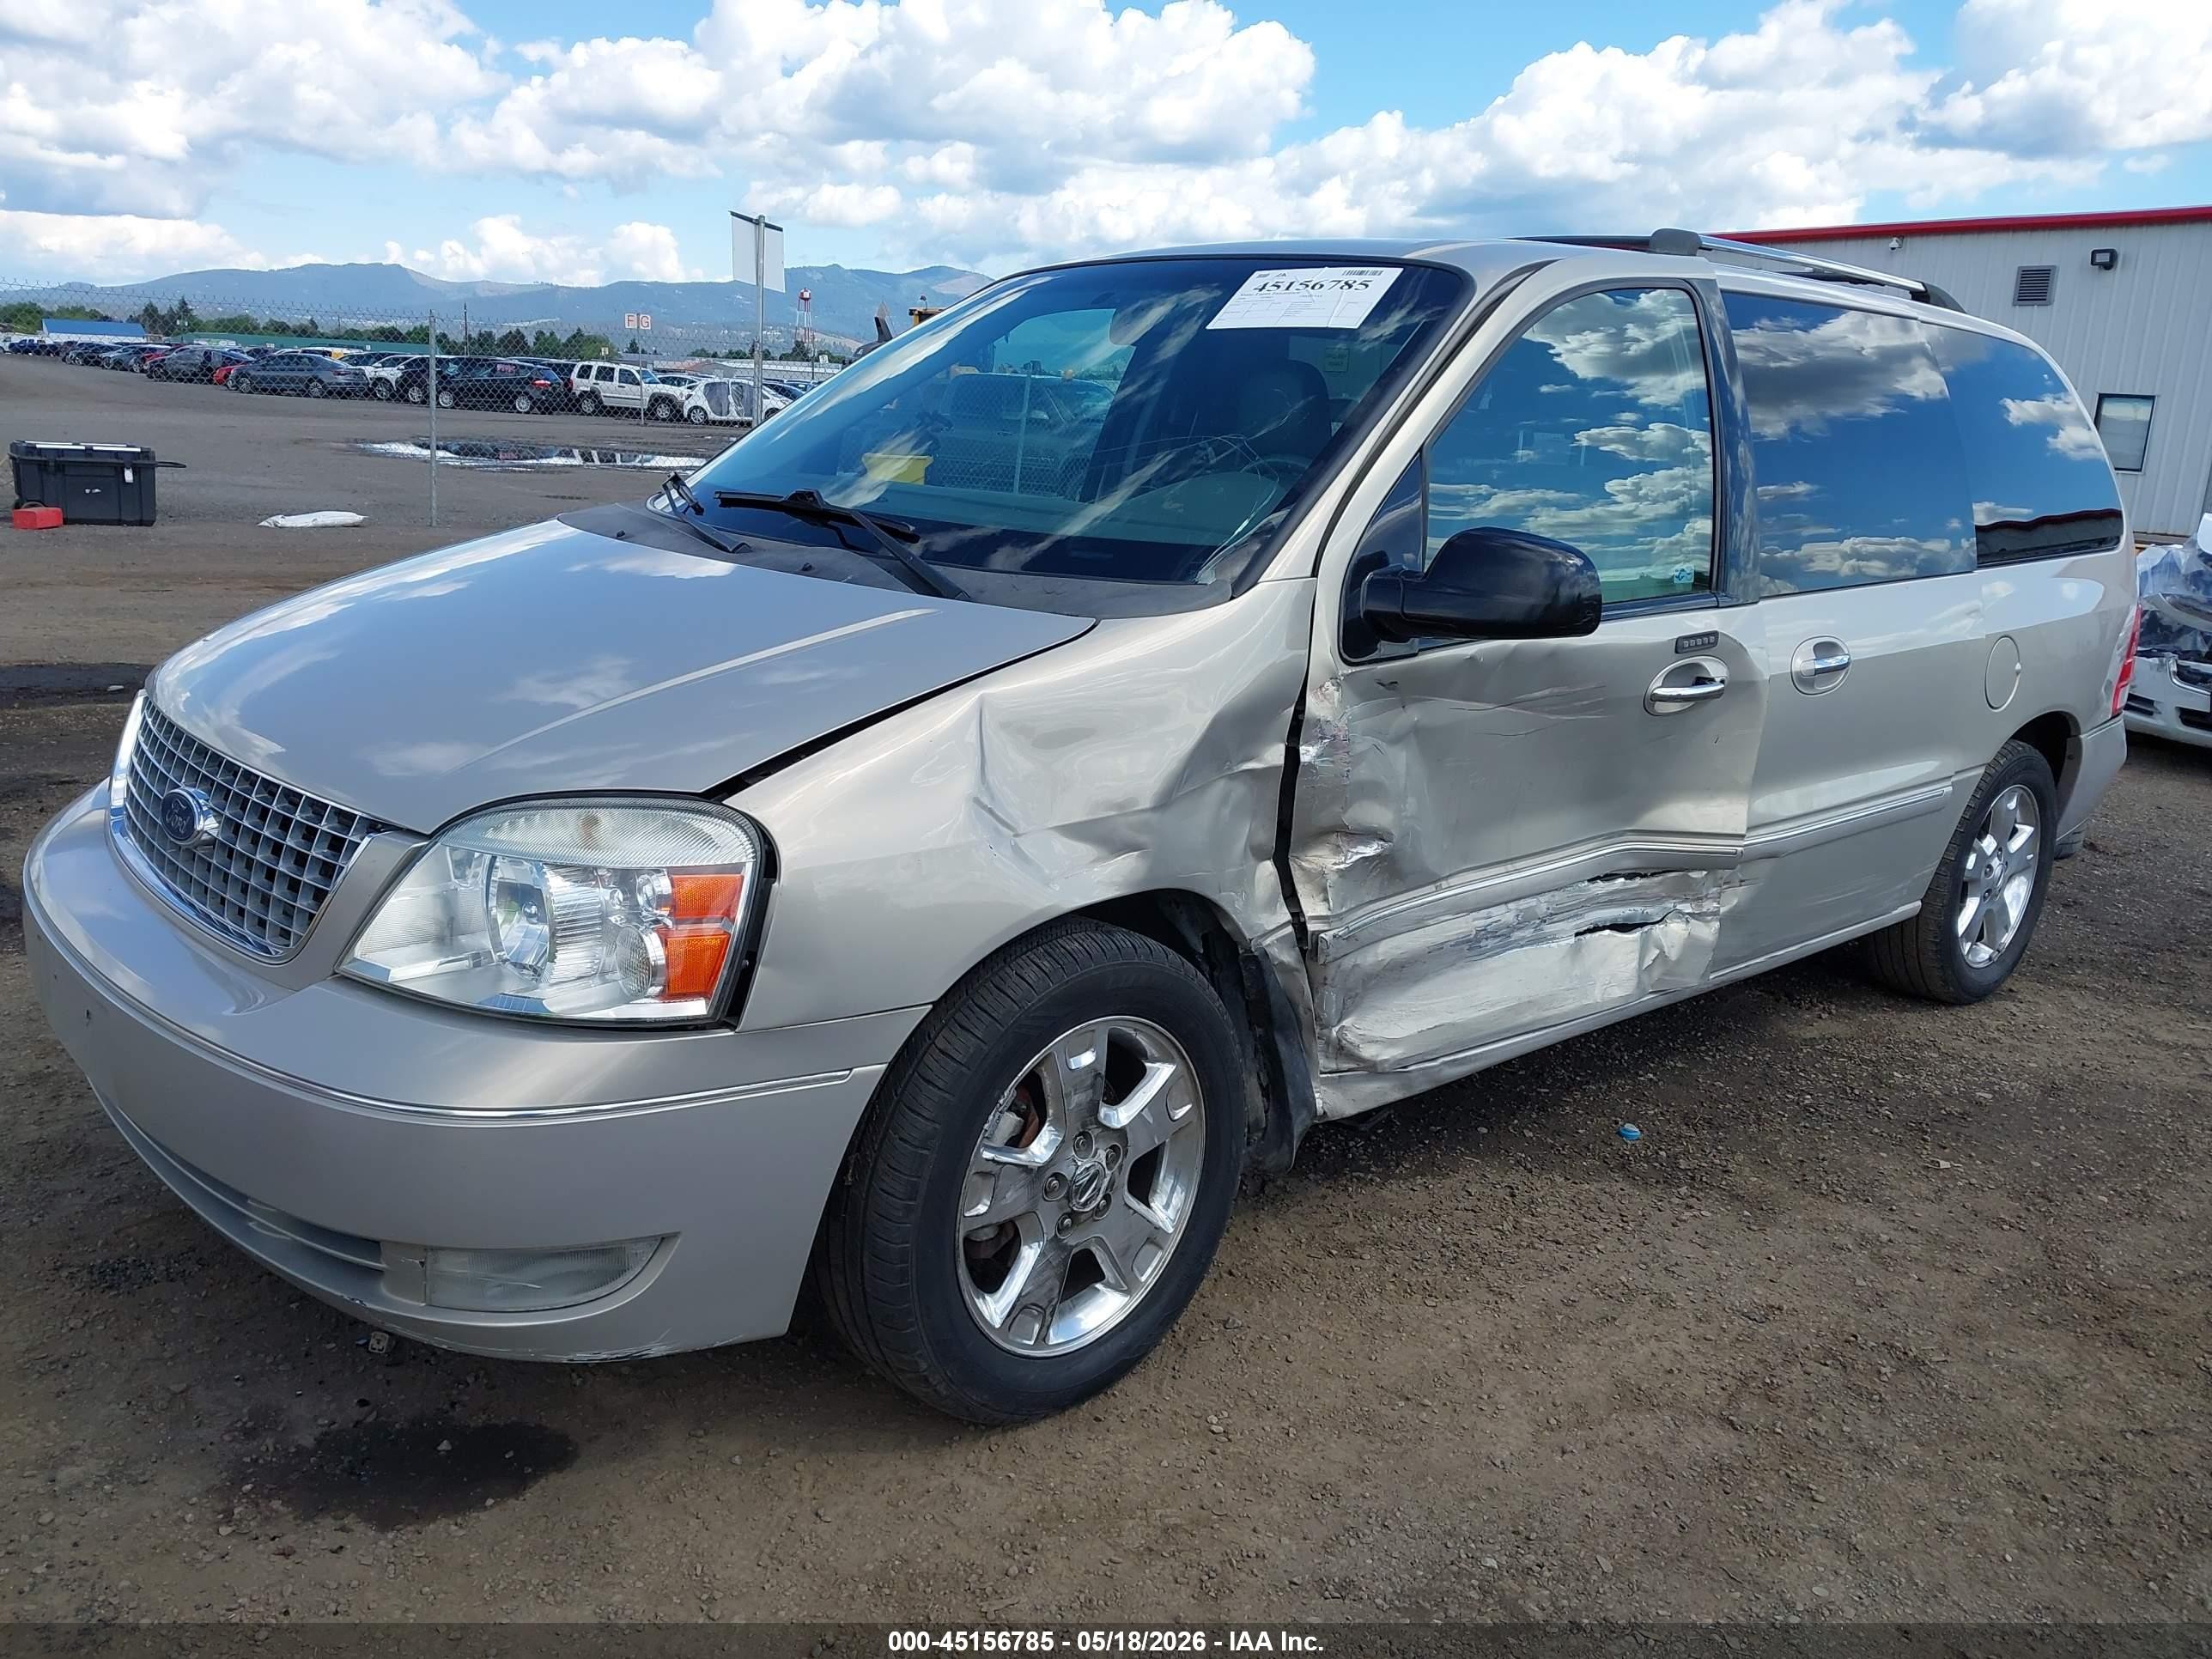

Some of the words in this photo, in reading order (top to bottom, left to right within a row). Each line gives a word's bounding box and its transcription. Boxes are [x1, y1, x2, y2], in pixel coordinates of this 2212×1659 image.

[1254, 279, 1374, 292] 45156785
[627, 314, 635, 328] F
[640, 314, 650, 328] G
